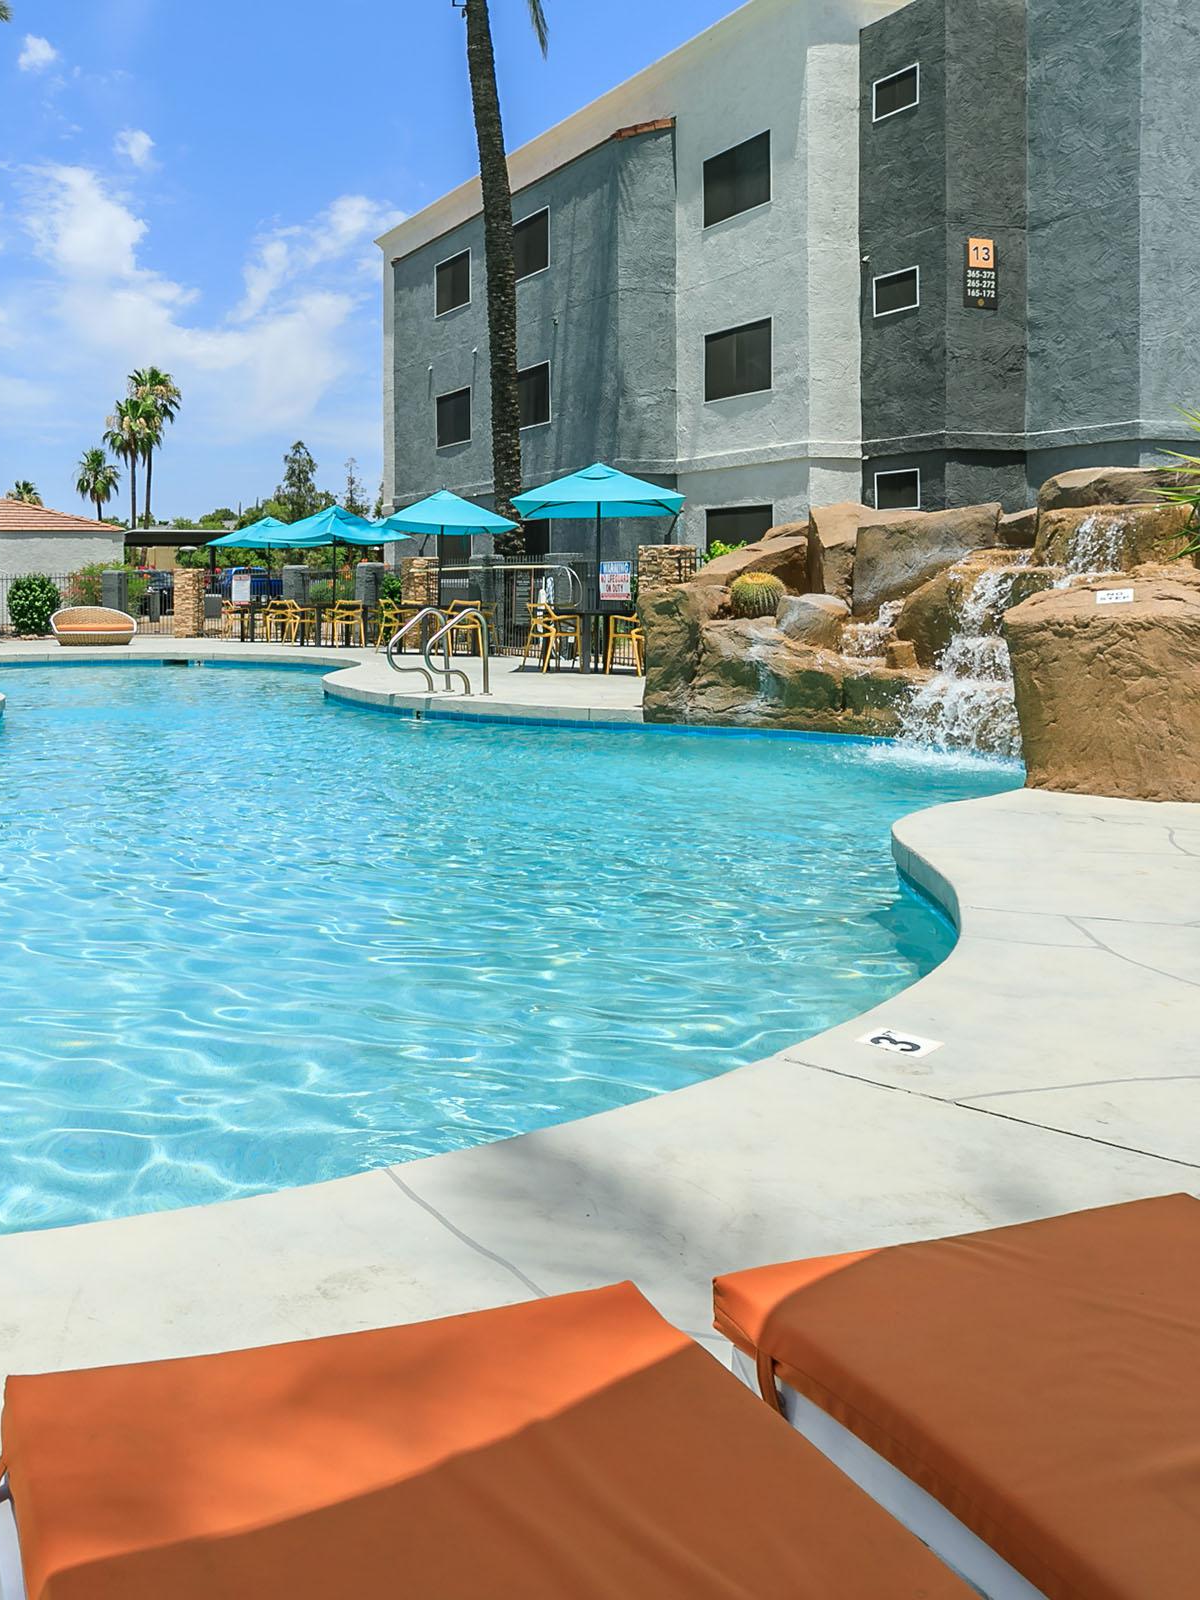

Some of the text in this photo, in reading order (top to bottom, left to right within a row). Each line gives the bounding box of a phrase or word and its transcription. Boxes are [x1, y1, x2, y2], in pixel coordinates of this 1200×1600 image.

[973, 246, 990, 261] 13
[966, 270, 995, 279] 365-372
[966, 279, 995, 288] 265-272
[967, 289, 995, 298] 165-172
[606, 584, 623, 592] ON DUTY
[870, 1036, 921, 1052] 3
